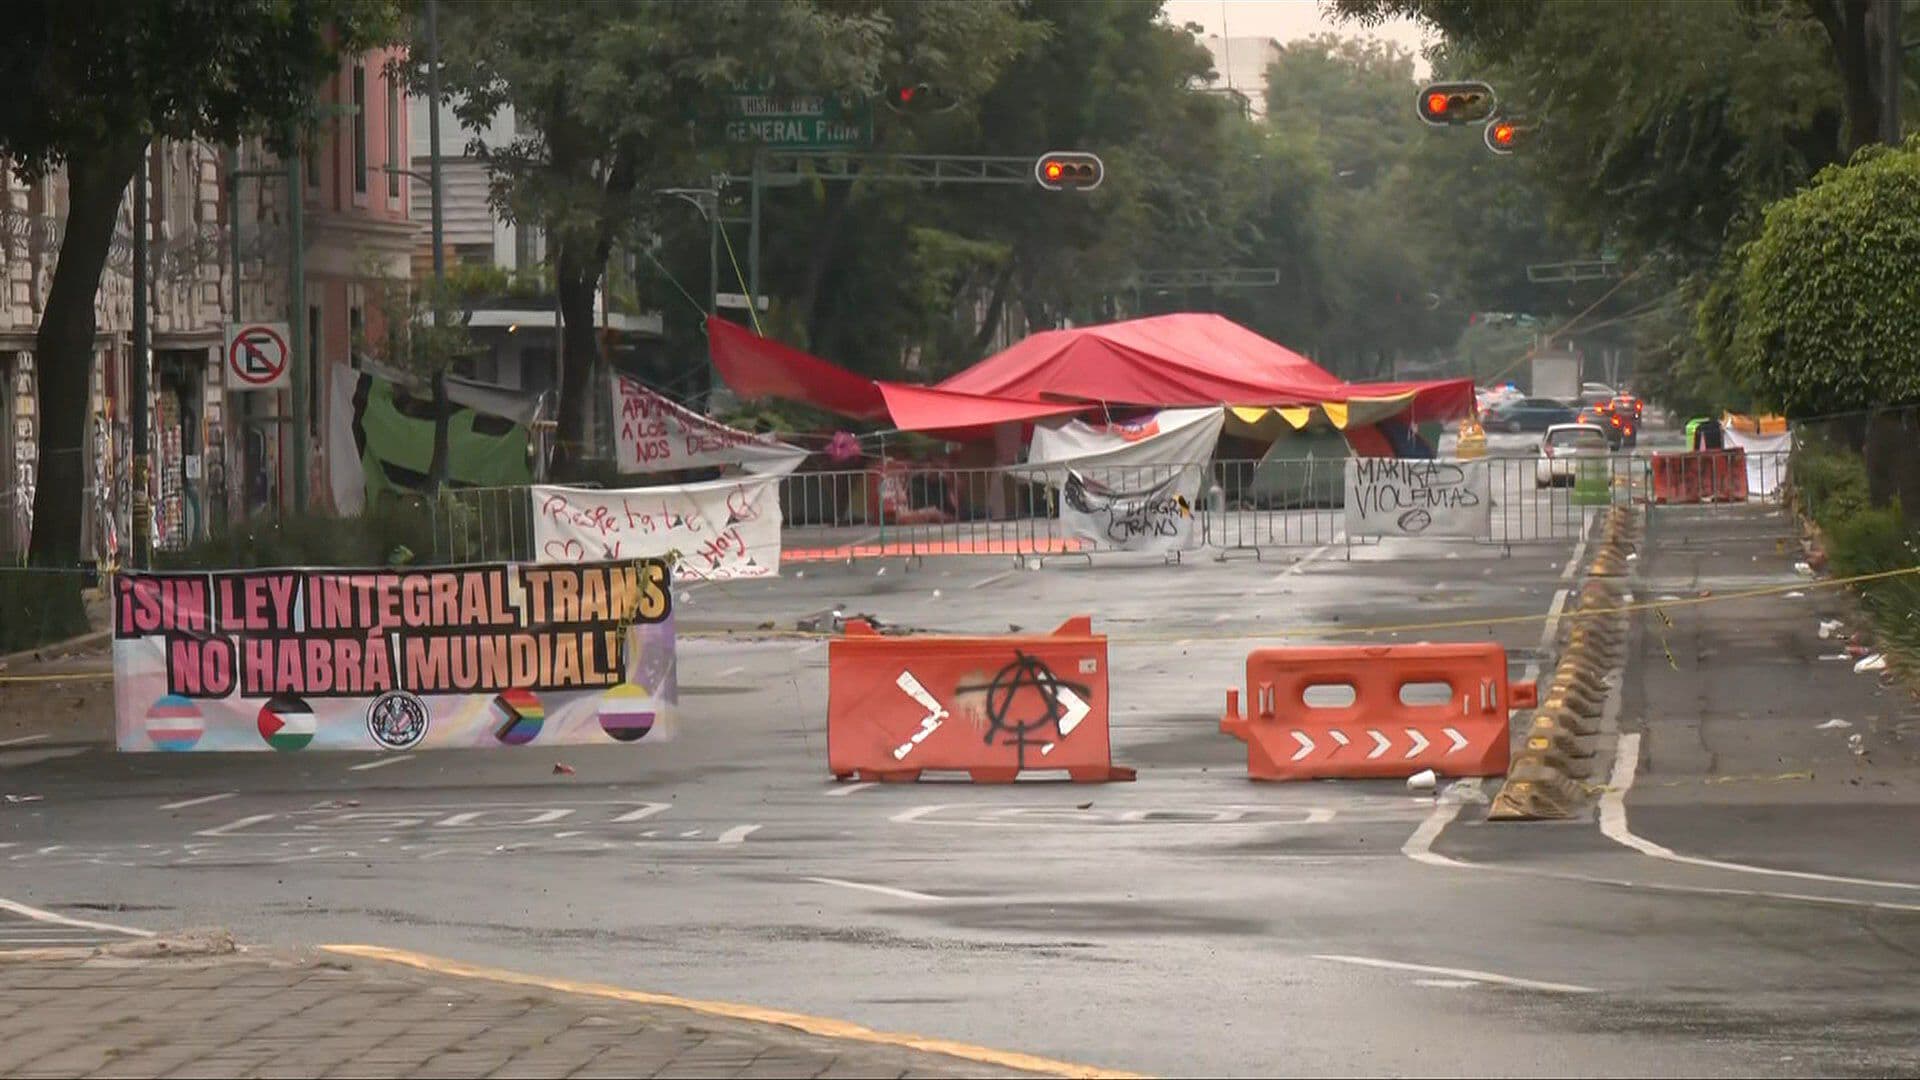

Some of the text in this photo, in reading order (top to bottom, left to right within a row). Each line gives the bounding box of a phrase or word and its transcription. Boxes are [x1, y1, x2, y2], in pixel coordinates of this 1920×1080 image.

[725, 119, 809, 143] GENERAL
[636, 441, 670, 464] NOS
[1354, 485, 1478, 519] VIOLENTAS
[697, 527, 745, 565] Hay
[119, 564, 666, 633] ¡SIN LEY INTEGRAL TRANS
[171, 627, 619, 695] NO HABRÁ MUNDIAL!
